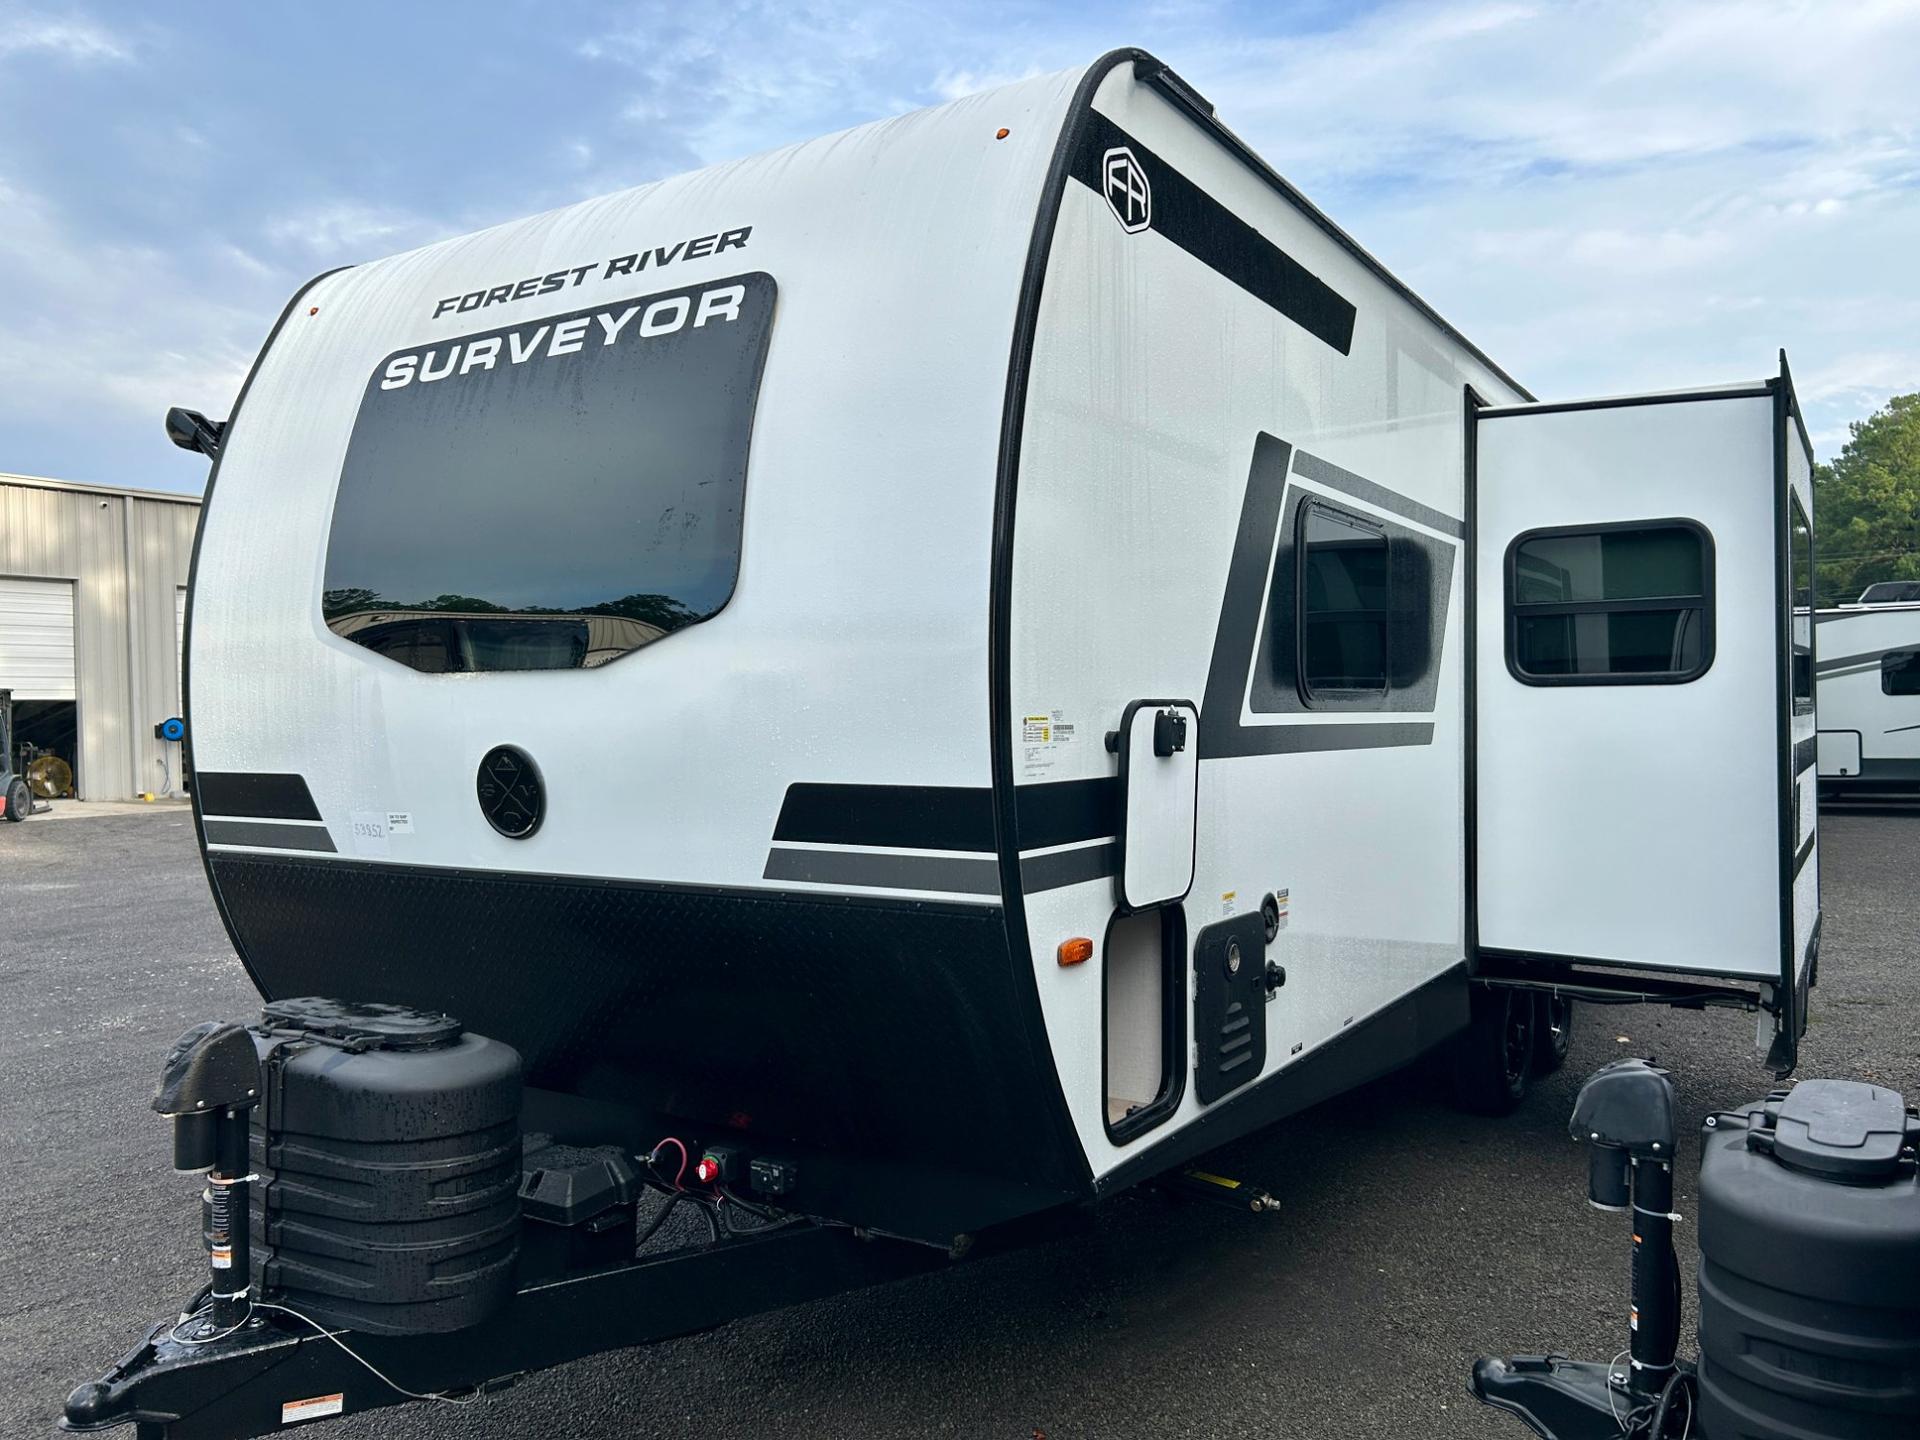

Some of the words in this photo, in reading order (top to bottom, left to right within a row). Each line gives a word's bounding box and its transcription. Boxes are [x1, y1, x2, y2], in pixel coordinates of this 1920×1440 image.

[431, 262, 599, 320] FOREST
[602, 225, 753, 280] RIVER
[380, 284, 746, 391] SURVEYOR
